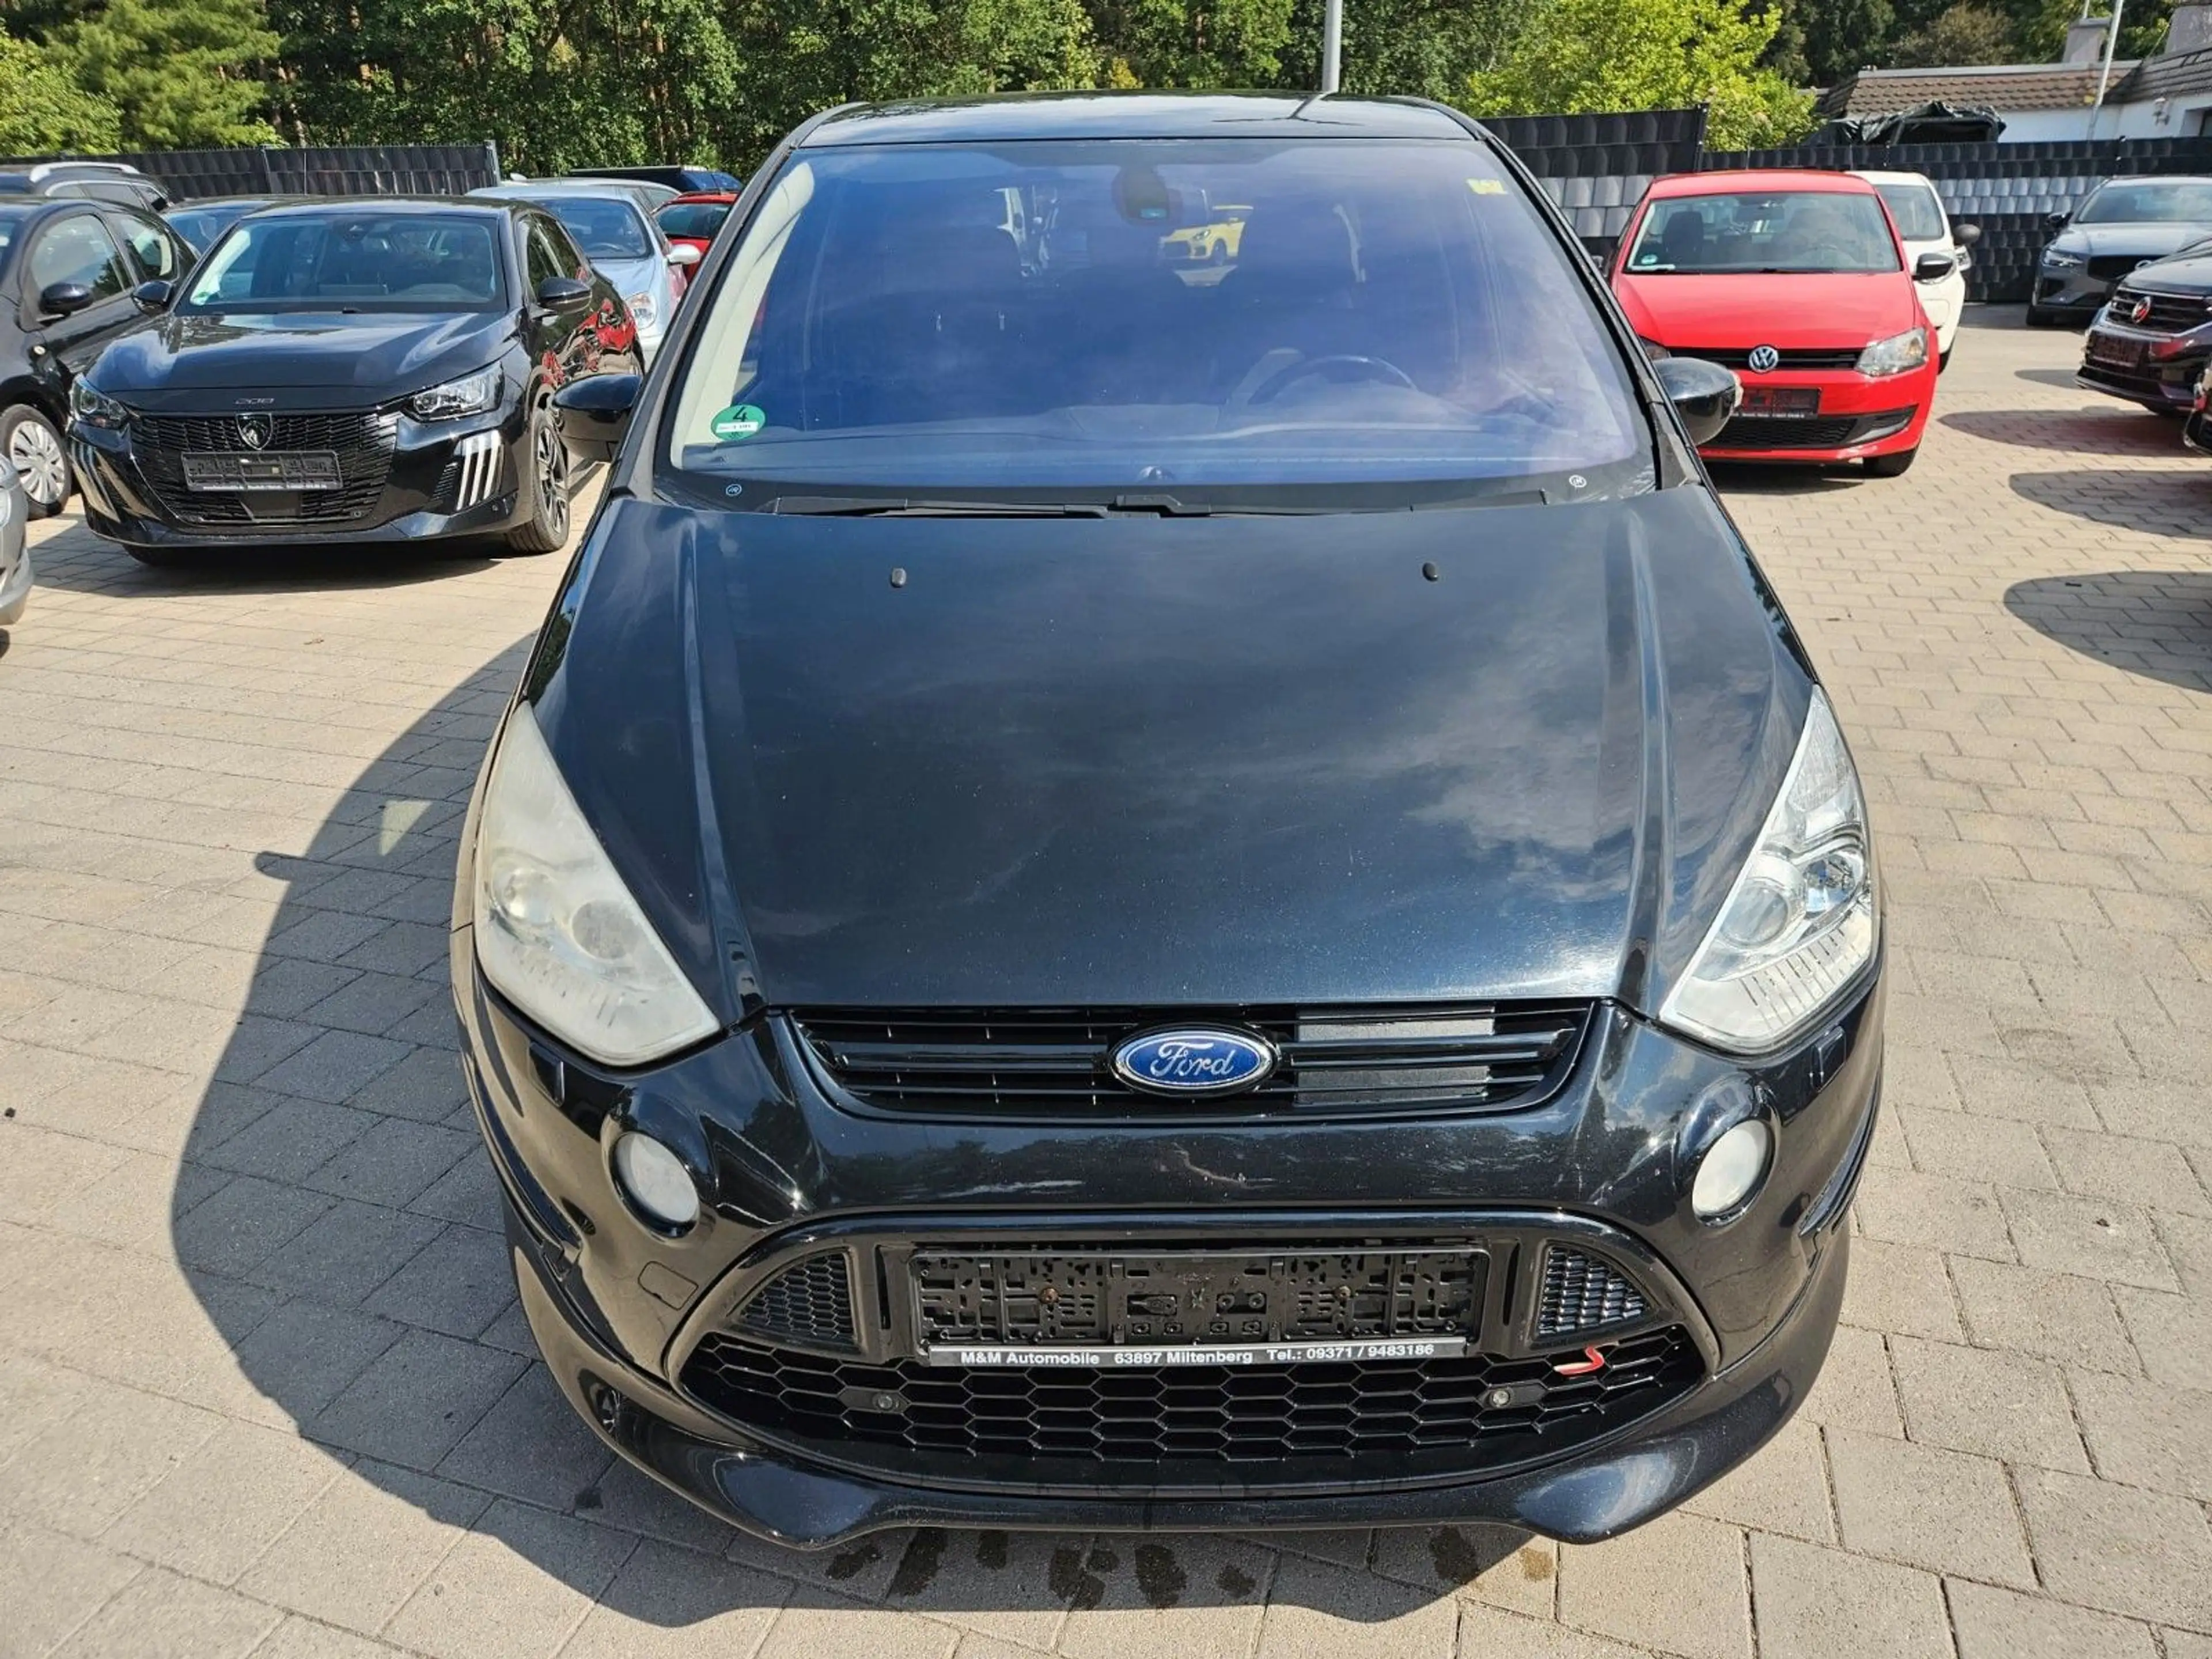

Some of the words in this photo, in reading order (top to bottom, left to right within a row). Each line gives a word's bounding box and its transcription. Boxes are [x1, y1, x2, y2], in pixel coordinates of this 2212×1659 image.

[733, 406, 748, 422] 4
[1150, 1041, 1235, 1077] Ford
[961, 1352, 1001, 1363] M&M
[1006, 1353, 1100, 1365] Automobile
[1115, 1351, 1161, 1364] 63897
[1166, 1351, 1253, 1363] Miltenberg
[1267, 1349, 1301, 1361] Tel.:
[1306, 1347, 1353, 1359] 09371
[1368, 1344, 1434, 1357] 9483186
